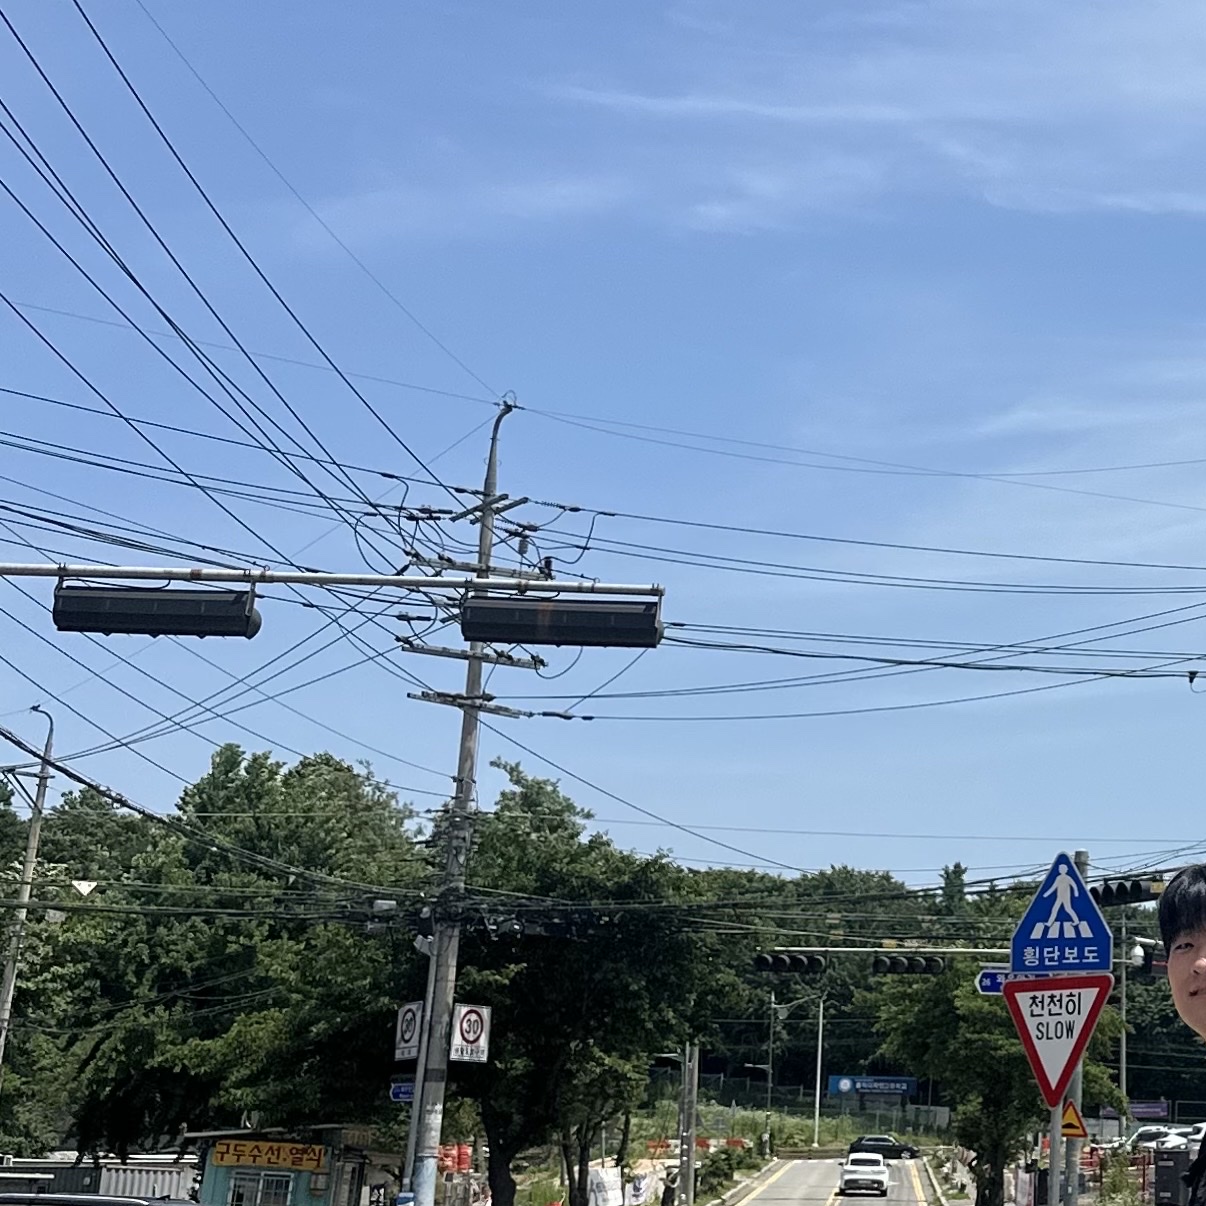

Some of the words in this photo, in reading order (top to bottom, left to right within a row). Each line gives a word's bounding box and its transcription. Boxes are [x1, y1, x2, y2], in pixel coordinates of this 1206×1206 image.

[1022, 945, 1100, 966] 횡단보도
[1029, 991, 1081, 1017] 천천히
[464, 1019, 479, 1034] 30
[1035, 1020, 1075, 1041] SLOW
